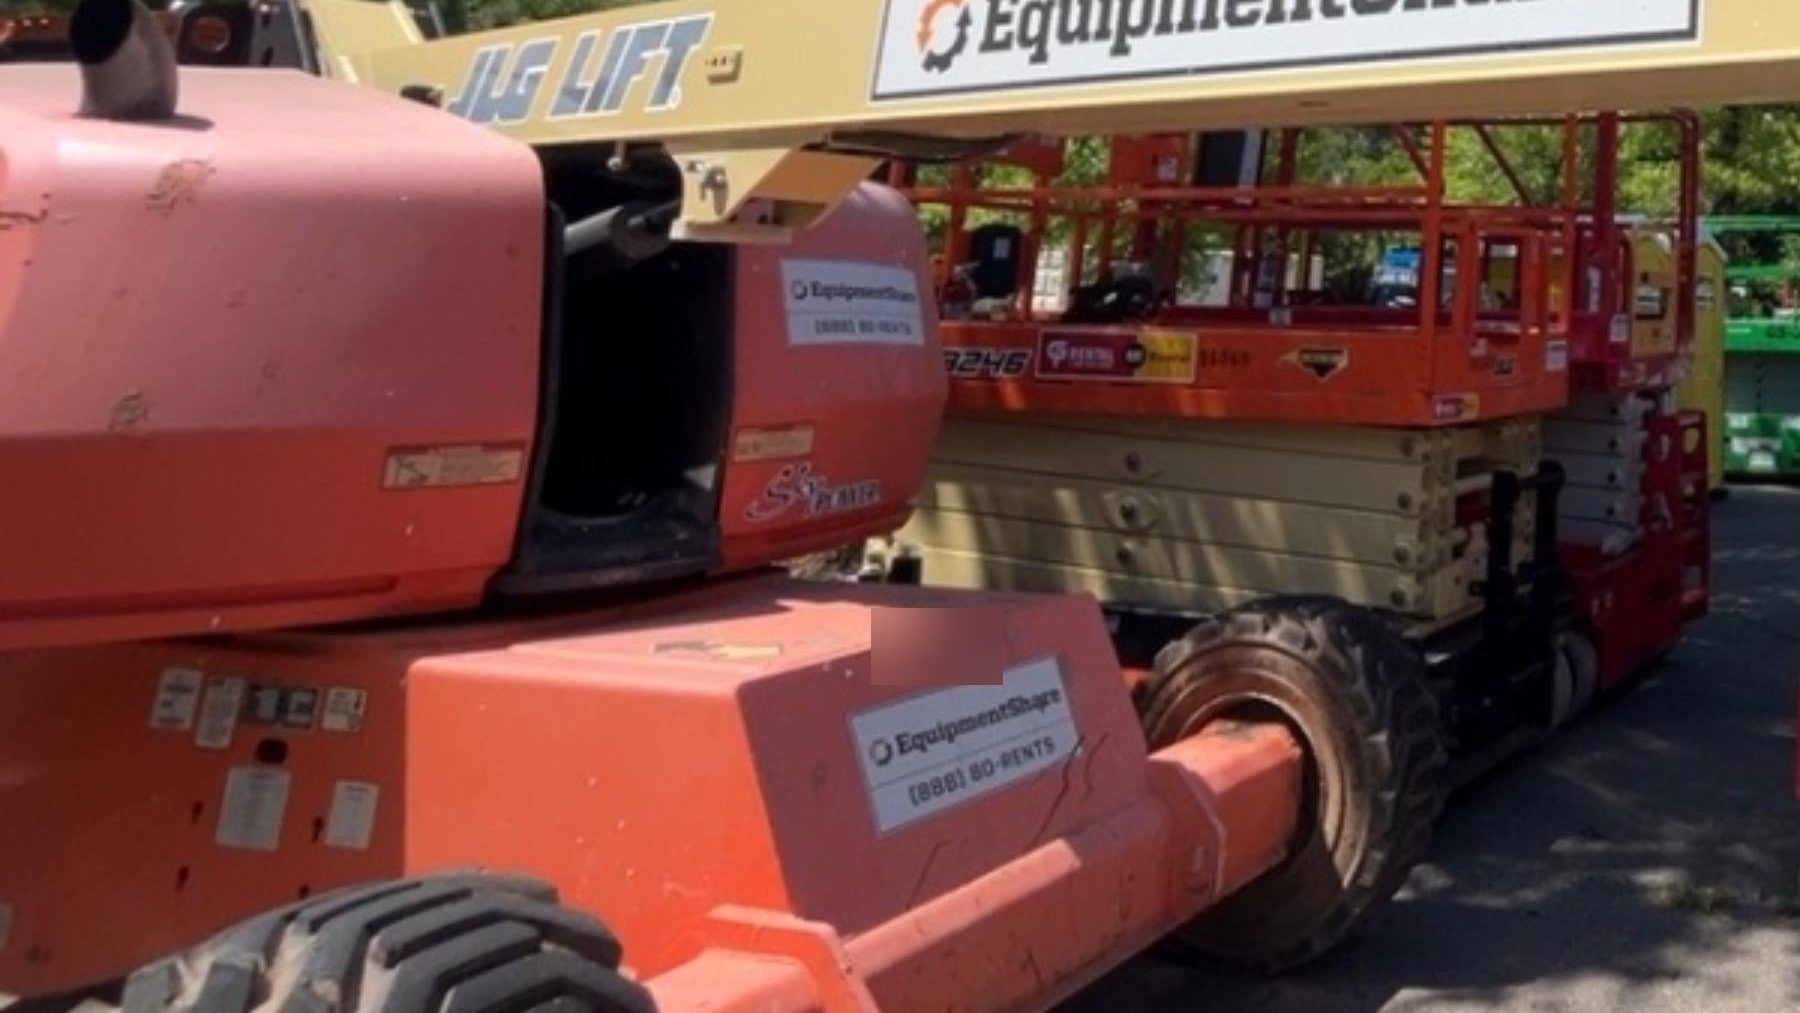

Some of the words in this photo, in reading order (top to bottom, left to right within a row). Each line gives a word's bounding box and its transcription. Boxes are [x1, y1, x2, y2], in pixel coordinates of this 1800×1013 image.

[446, 35, 562, 125] JLG
[545, 12, 715, 121] LIFT
[894, 688, 1061, 756] EquipmentShare
